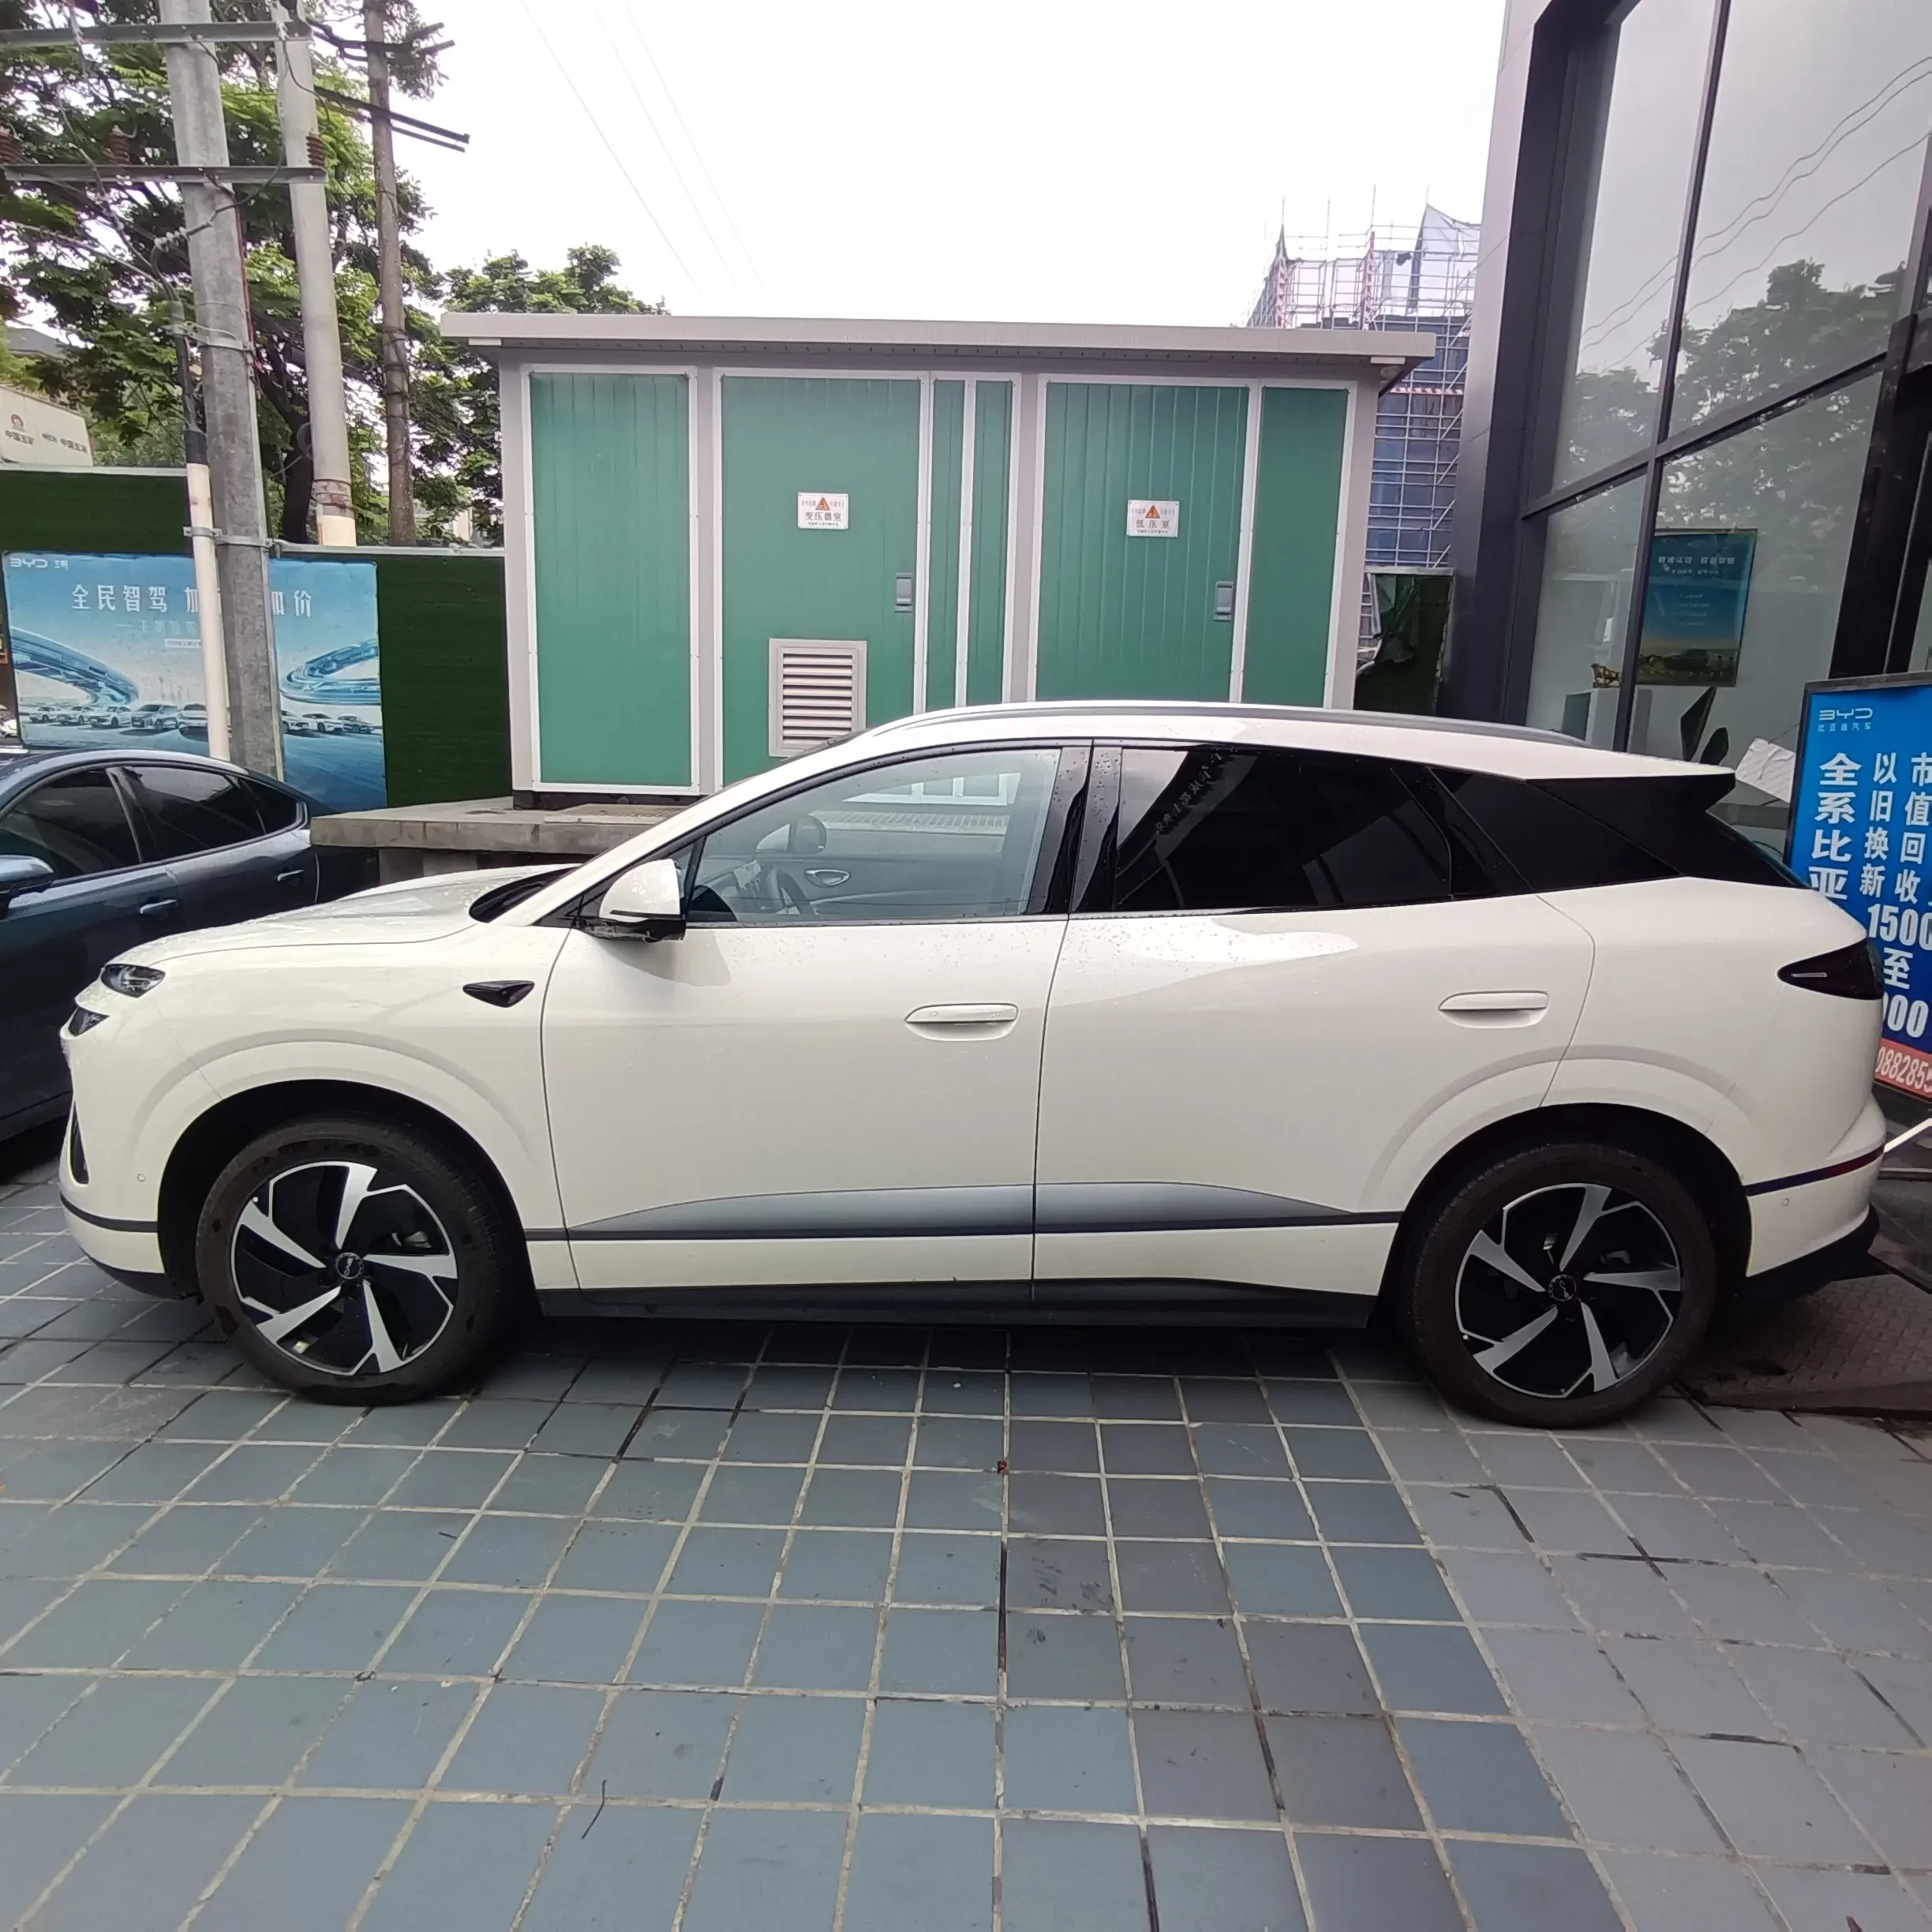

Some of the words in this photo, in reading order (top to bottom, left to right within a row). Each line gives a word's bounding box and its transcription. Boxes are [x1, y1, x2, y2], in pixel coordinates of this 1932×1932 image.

[9, 557, 48, 569] BYD
[71, 584, 168, 612] 全民智驾
[1818, 707, 1873, 721] BYD
[1859, 751, 1897, 898] 以旧换新
[1883, 947, 1913, 990] 至
